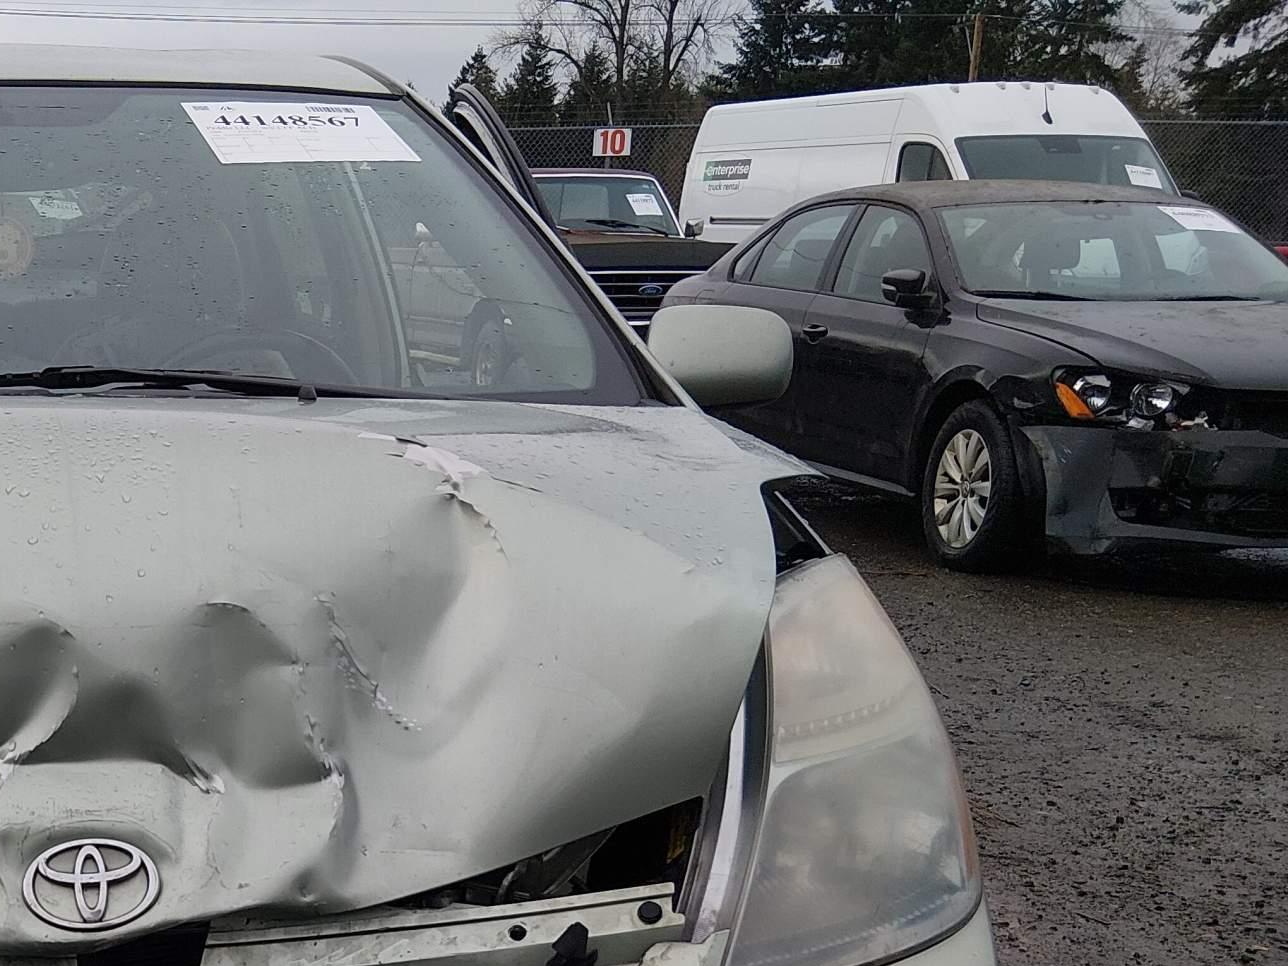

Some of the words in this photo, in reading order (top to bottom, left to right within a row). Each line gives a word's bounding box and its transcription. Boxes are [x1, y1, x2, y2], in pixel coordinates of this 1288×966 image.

[214, 114, 360, 127] 44148567
[600, 129, 625, 154] 10
[704, 162, 750, 178] enterprise
[708, 183, 722, 192] truck
[723, 182, 740, 191] rental
